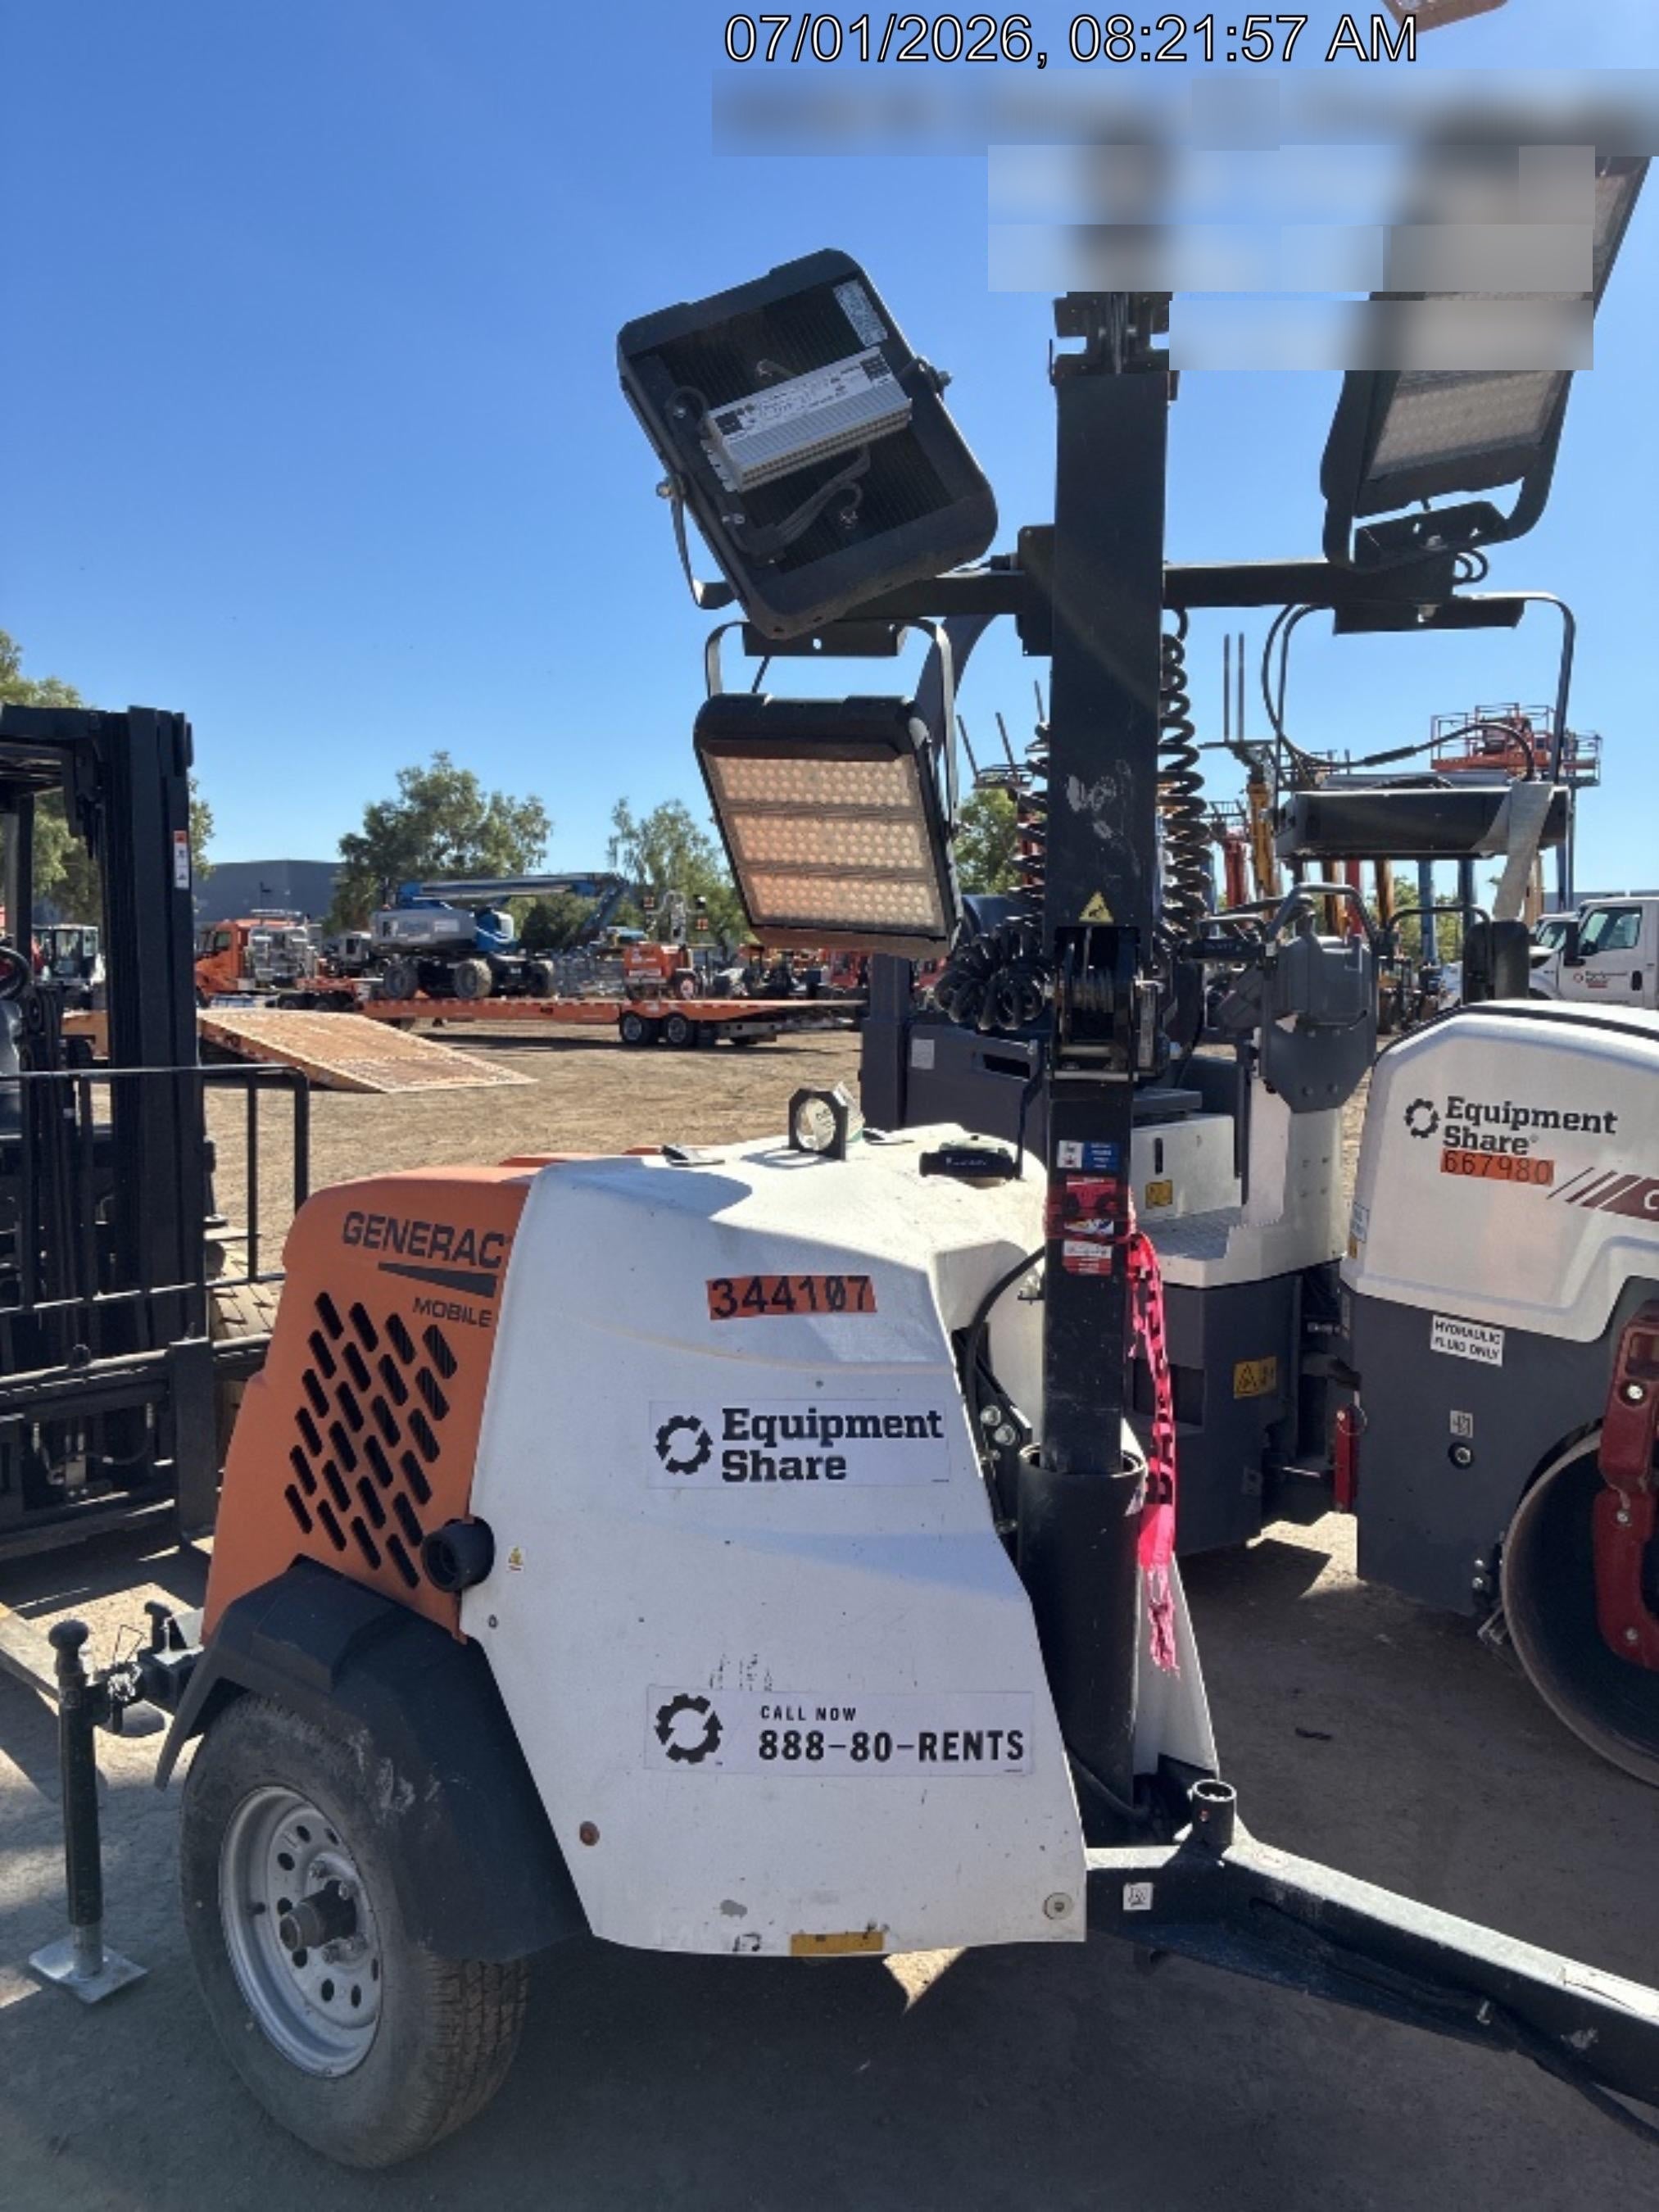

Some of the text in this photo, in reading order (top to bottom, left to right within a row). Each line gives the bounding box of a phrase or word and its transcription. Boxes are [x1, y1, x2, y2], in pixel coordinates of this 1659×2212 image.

[1445, 1095, 1618, 1135] Equipment
[1443, 1125, 1530, 1155] Share
[1444, 1149, 1551, 1185] 667980
[342, 1211, 505, 1269] GENERAC
[412, 1297, 492, 1328] MOBILE
[712, 1275, 871, 1318] 344107
[722, 1407, 944, 1448] Equipment
[722, 1449, 847, 1483] Share
[760, 1705, 857, 1721] CALL NOW
[759, 1729, 1024, 1762] 888-80-RENTS
